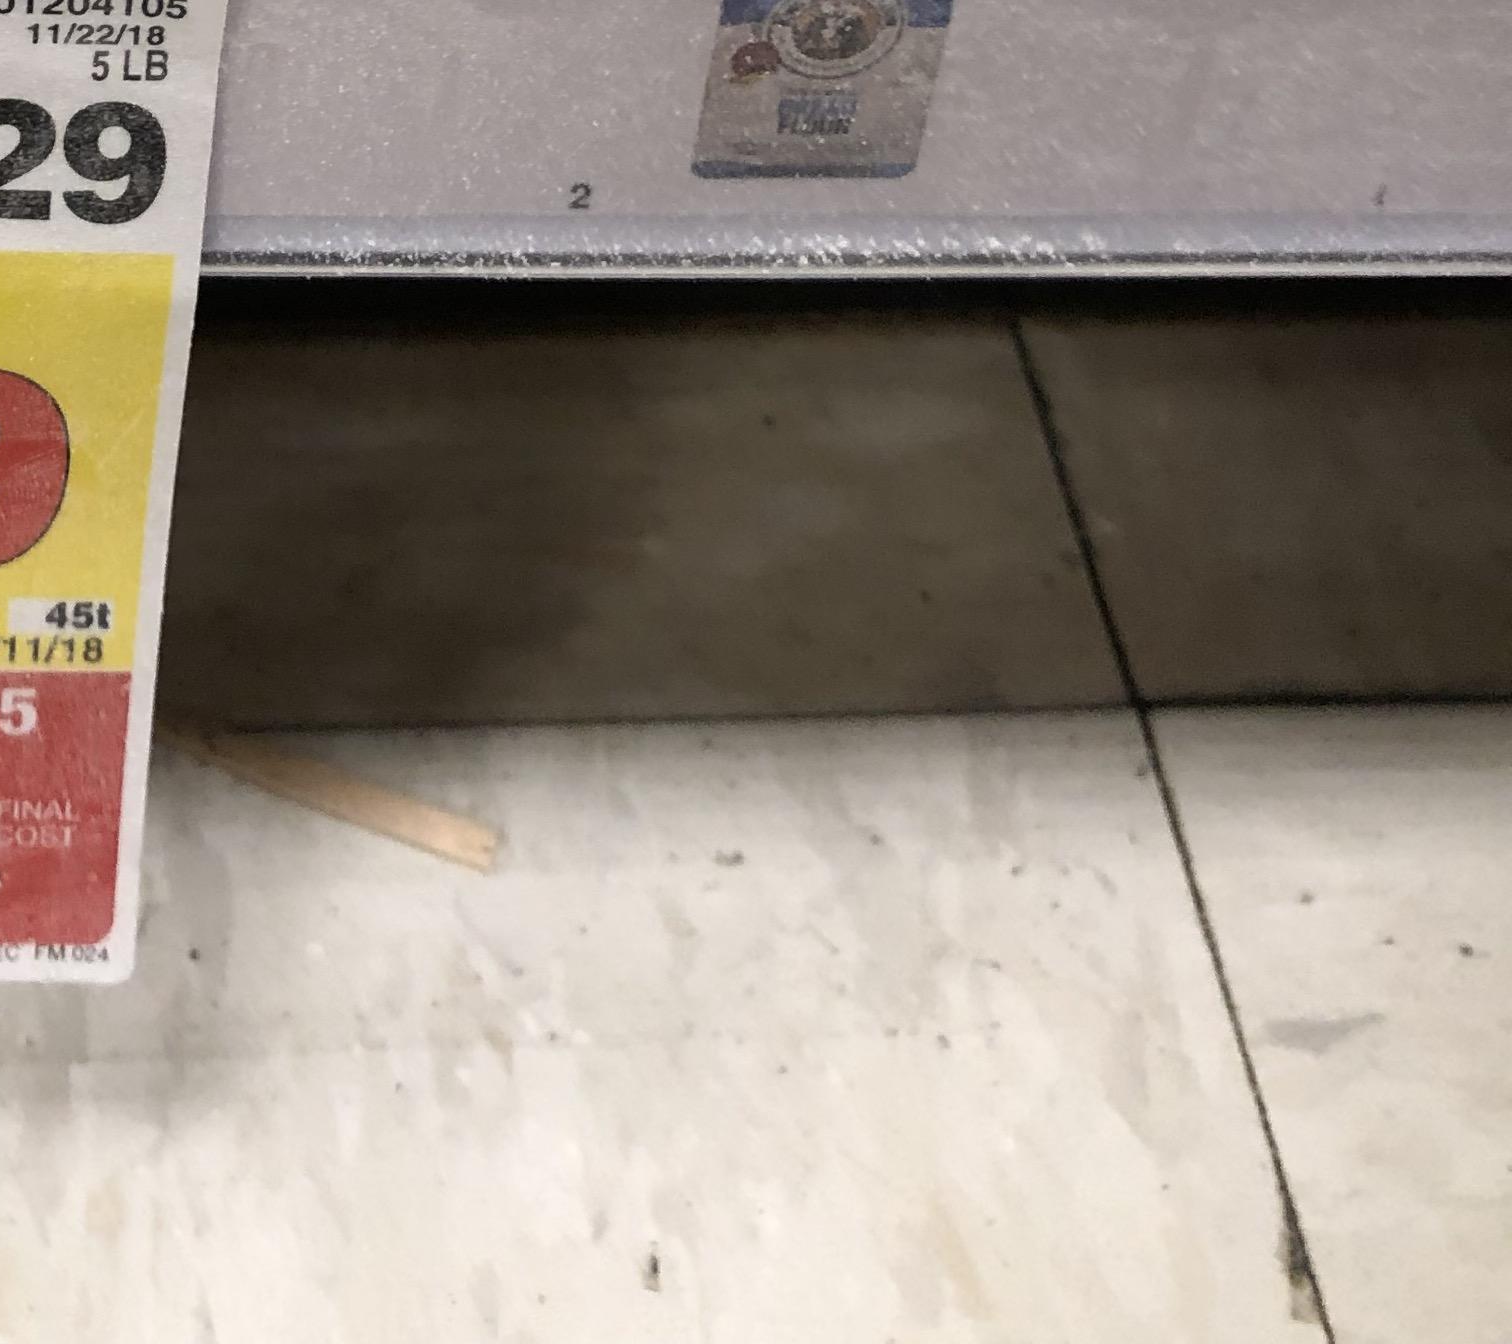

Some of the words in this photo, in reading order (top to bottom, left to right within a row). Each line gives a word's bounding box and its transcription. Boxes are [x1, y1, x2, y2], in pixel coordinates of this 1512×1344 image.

[27, 21, 166, 47] 11/22/18
[90, 49, 110, 82] 5
[122, 48, 170, 83] LB
[568, 182, 592, 209] 2
